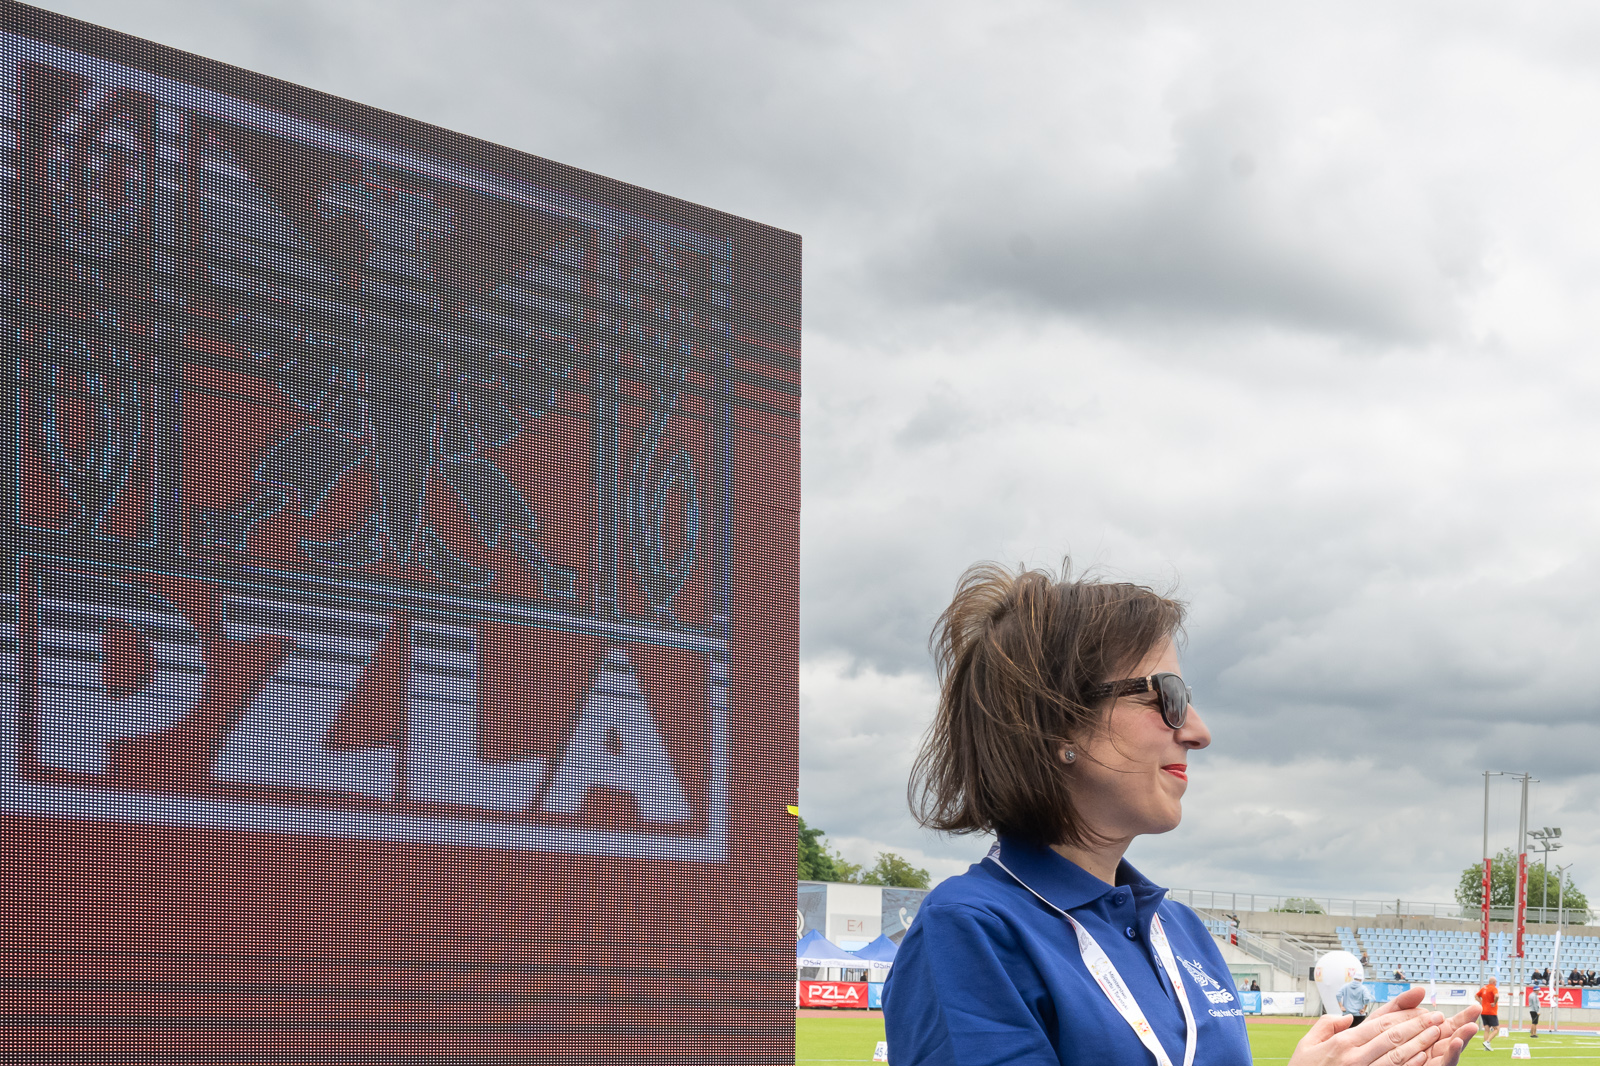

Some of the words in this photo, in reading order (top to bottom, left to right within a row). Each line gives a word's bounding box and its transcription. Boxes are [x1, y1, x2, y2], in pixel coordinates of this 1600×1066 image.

[36, 570, 692, 824] PZLA
[808, 985, 859, 1000] PZLA
[1513, 1047, 1521, 1055] 30
